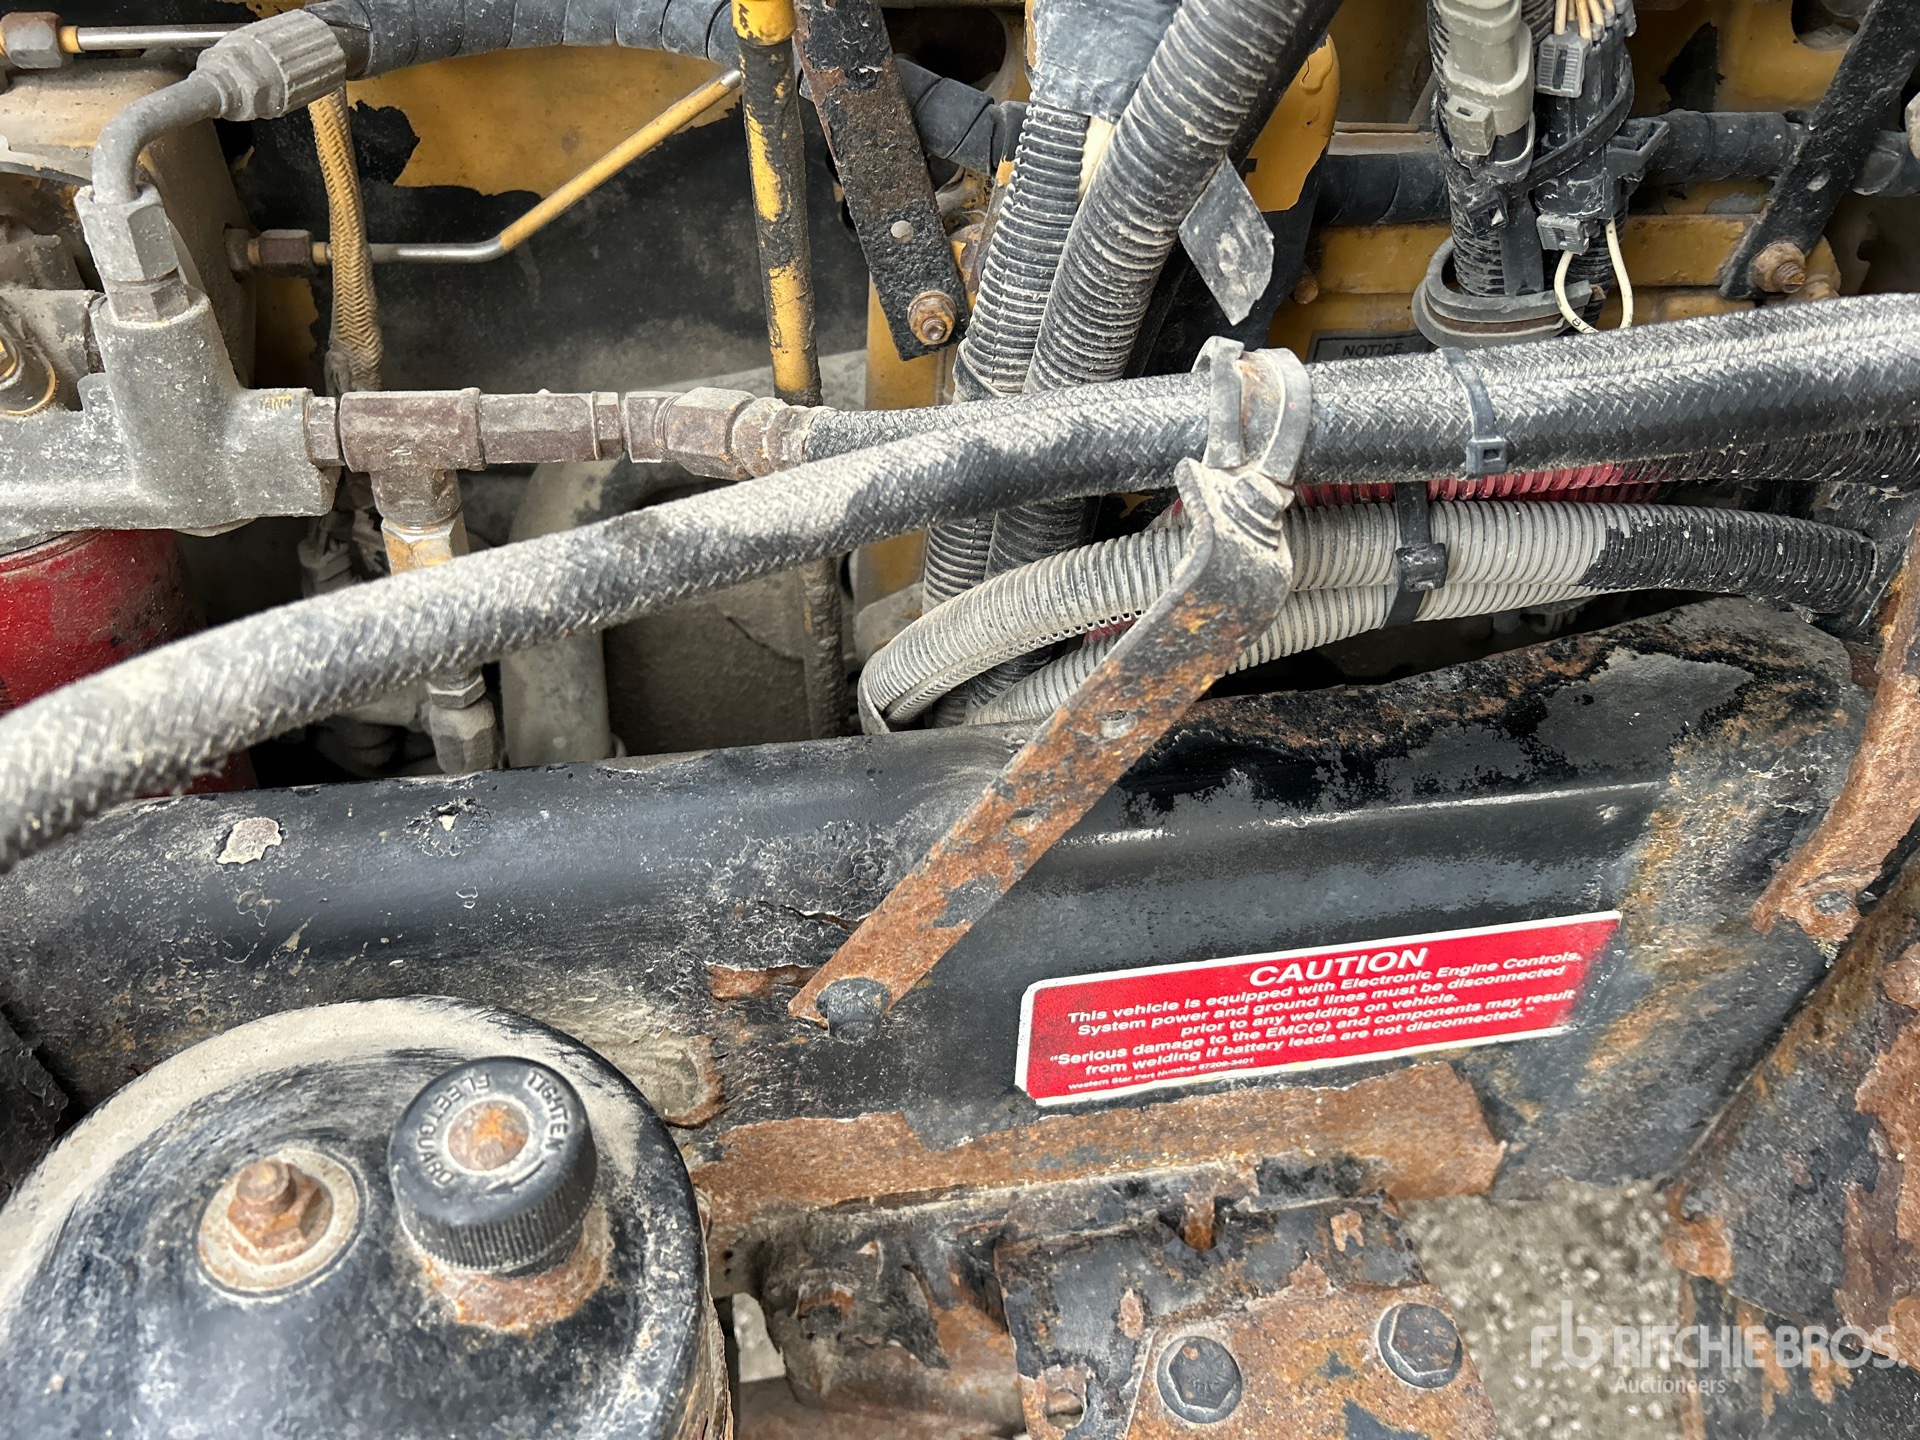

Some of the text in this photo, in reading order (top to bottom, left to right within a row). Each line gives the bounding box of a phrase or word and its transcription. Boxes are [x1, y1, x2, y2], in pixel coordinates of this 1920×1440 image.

[1342, 342, 1404, 357] NOTICE
[1067, 951, 1582, 1024] This vehicle is equipped with Electronic Engine Controls.
[1077, 965, 1567, 1036] System power and ground lines must be disconnected
[1249, 948, 1428, 986] CAUTION
[1050, 989, 1577, 1065] “Serious damage to the EMC(s) and components may result
[1084, 1006, 1535, 1076] from welding if battery leads are not disconnected.”
[1180, 993, 1460, 1038] prior to any welding on vehicle.
